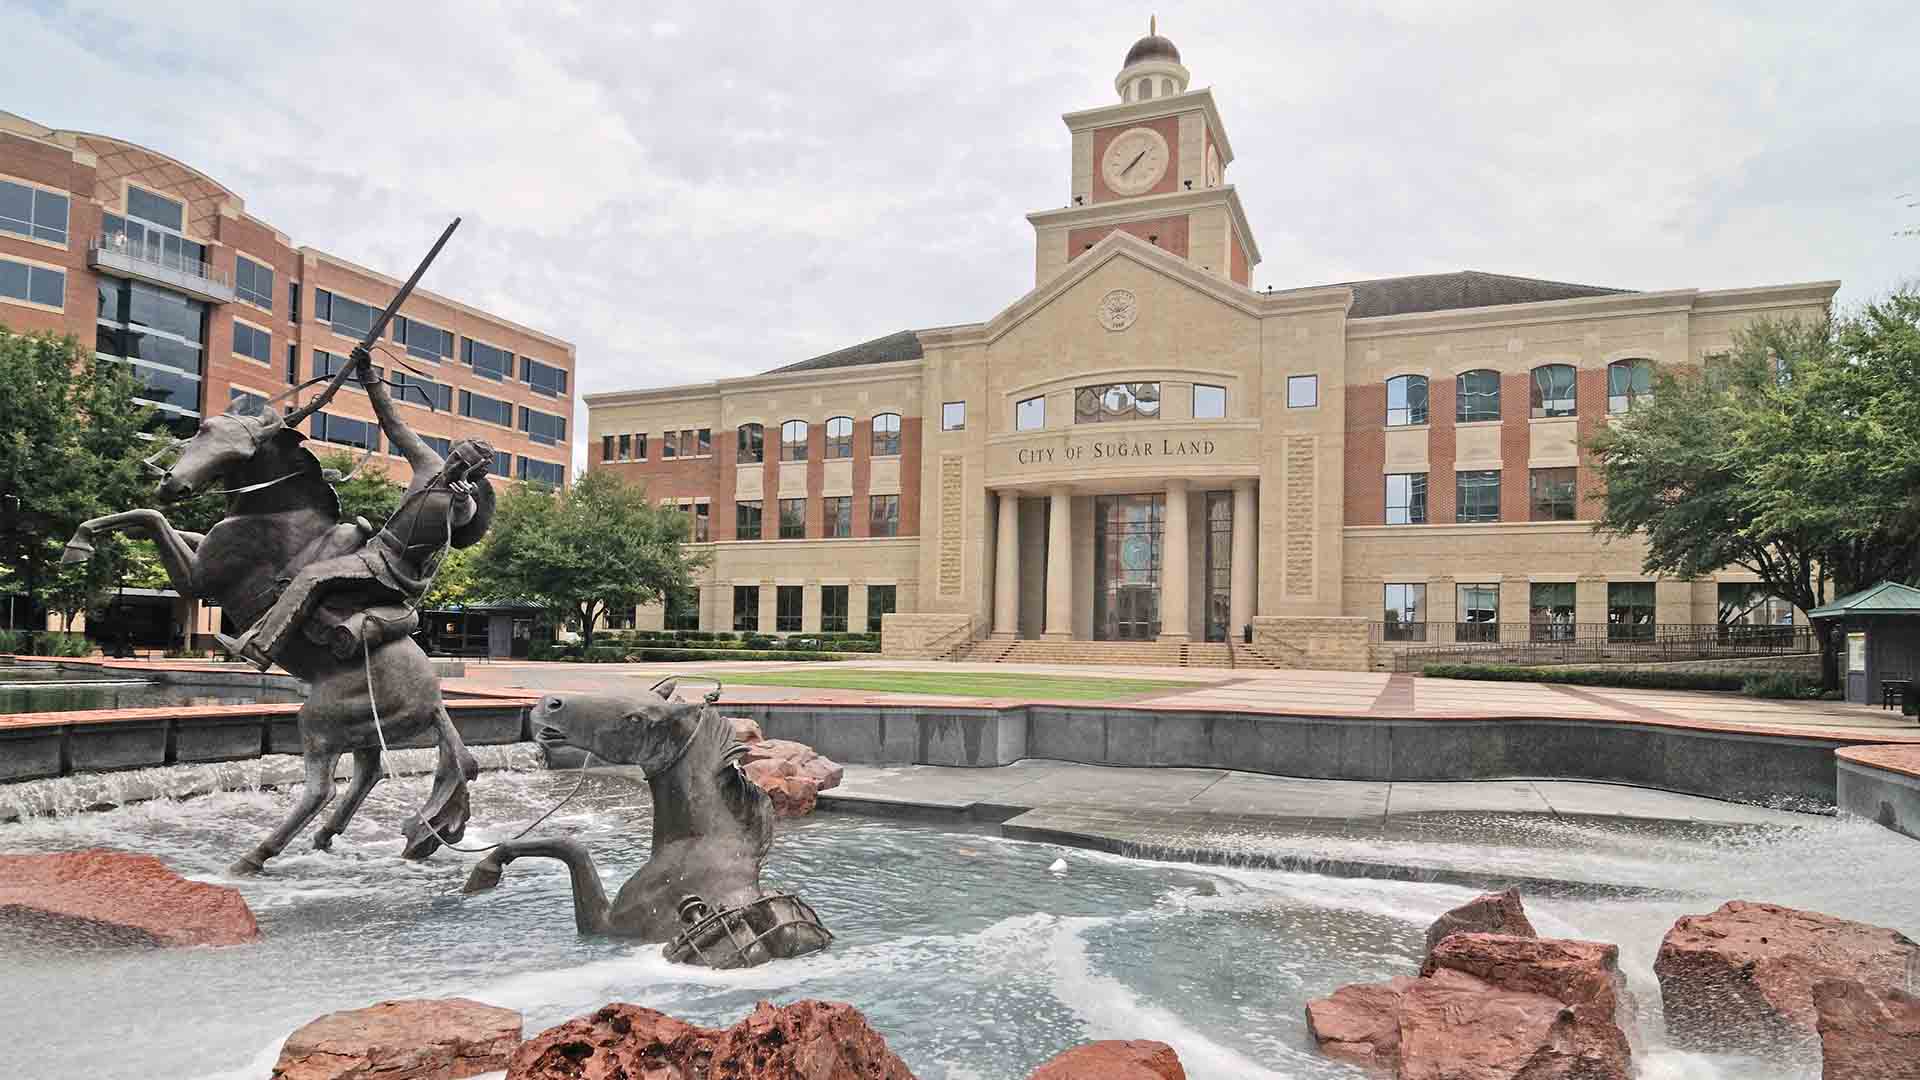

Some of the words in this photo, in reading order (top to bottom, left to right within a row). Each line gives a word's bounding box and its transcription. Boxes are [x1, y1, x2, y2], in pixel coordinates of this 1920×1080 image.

[1018, 447, 1055, 464] CITY
[1066, 446, 1083, 459] OF
[1093, 442, 1153, 458] SUGAR
[1163, 439, 1214, 456] LAND
